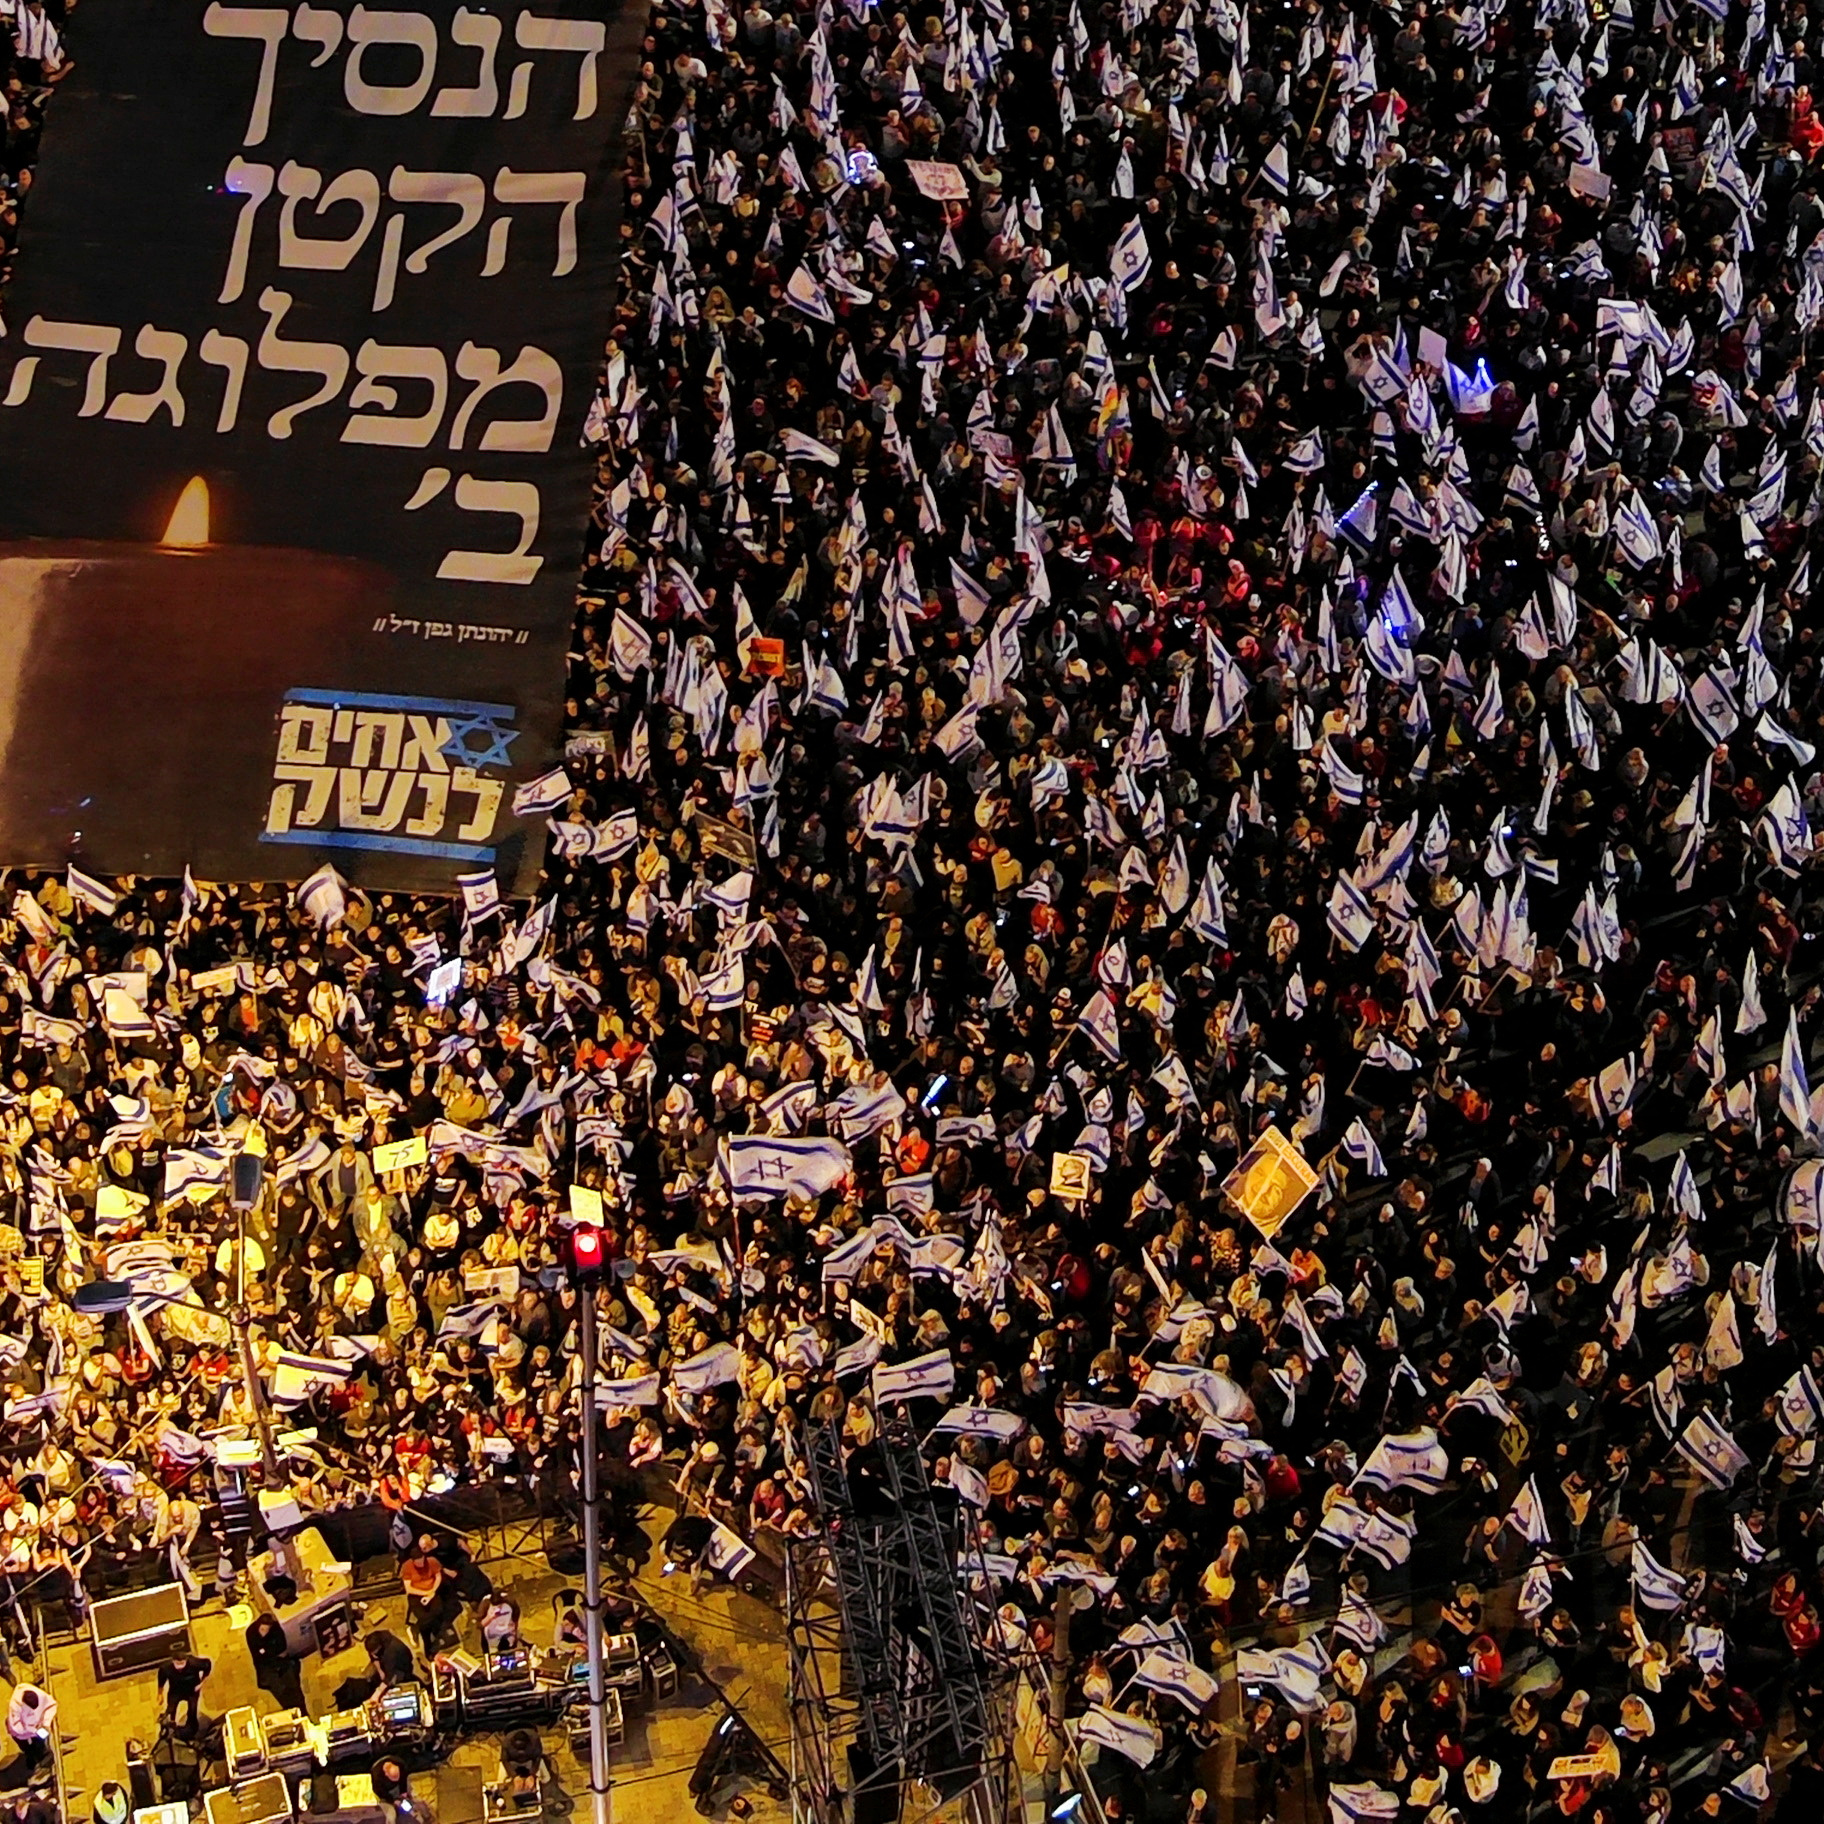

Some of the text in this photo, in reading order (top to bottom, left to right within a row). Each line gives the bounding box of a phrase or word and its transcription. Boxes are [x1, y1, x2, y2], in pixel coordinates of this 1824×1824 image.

[202, 1, 606, 148] הנסיך
[217, 155, 587, 313] הקטן
[2, 286, 564, 453] מפלוגה
[424, 621, 453, 642] גפן
[276, 701, 453, 773] אחים
[267, 764, 507, 842] לנשק
